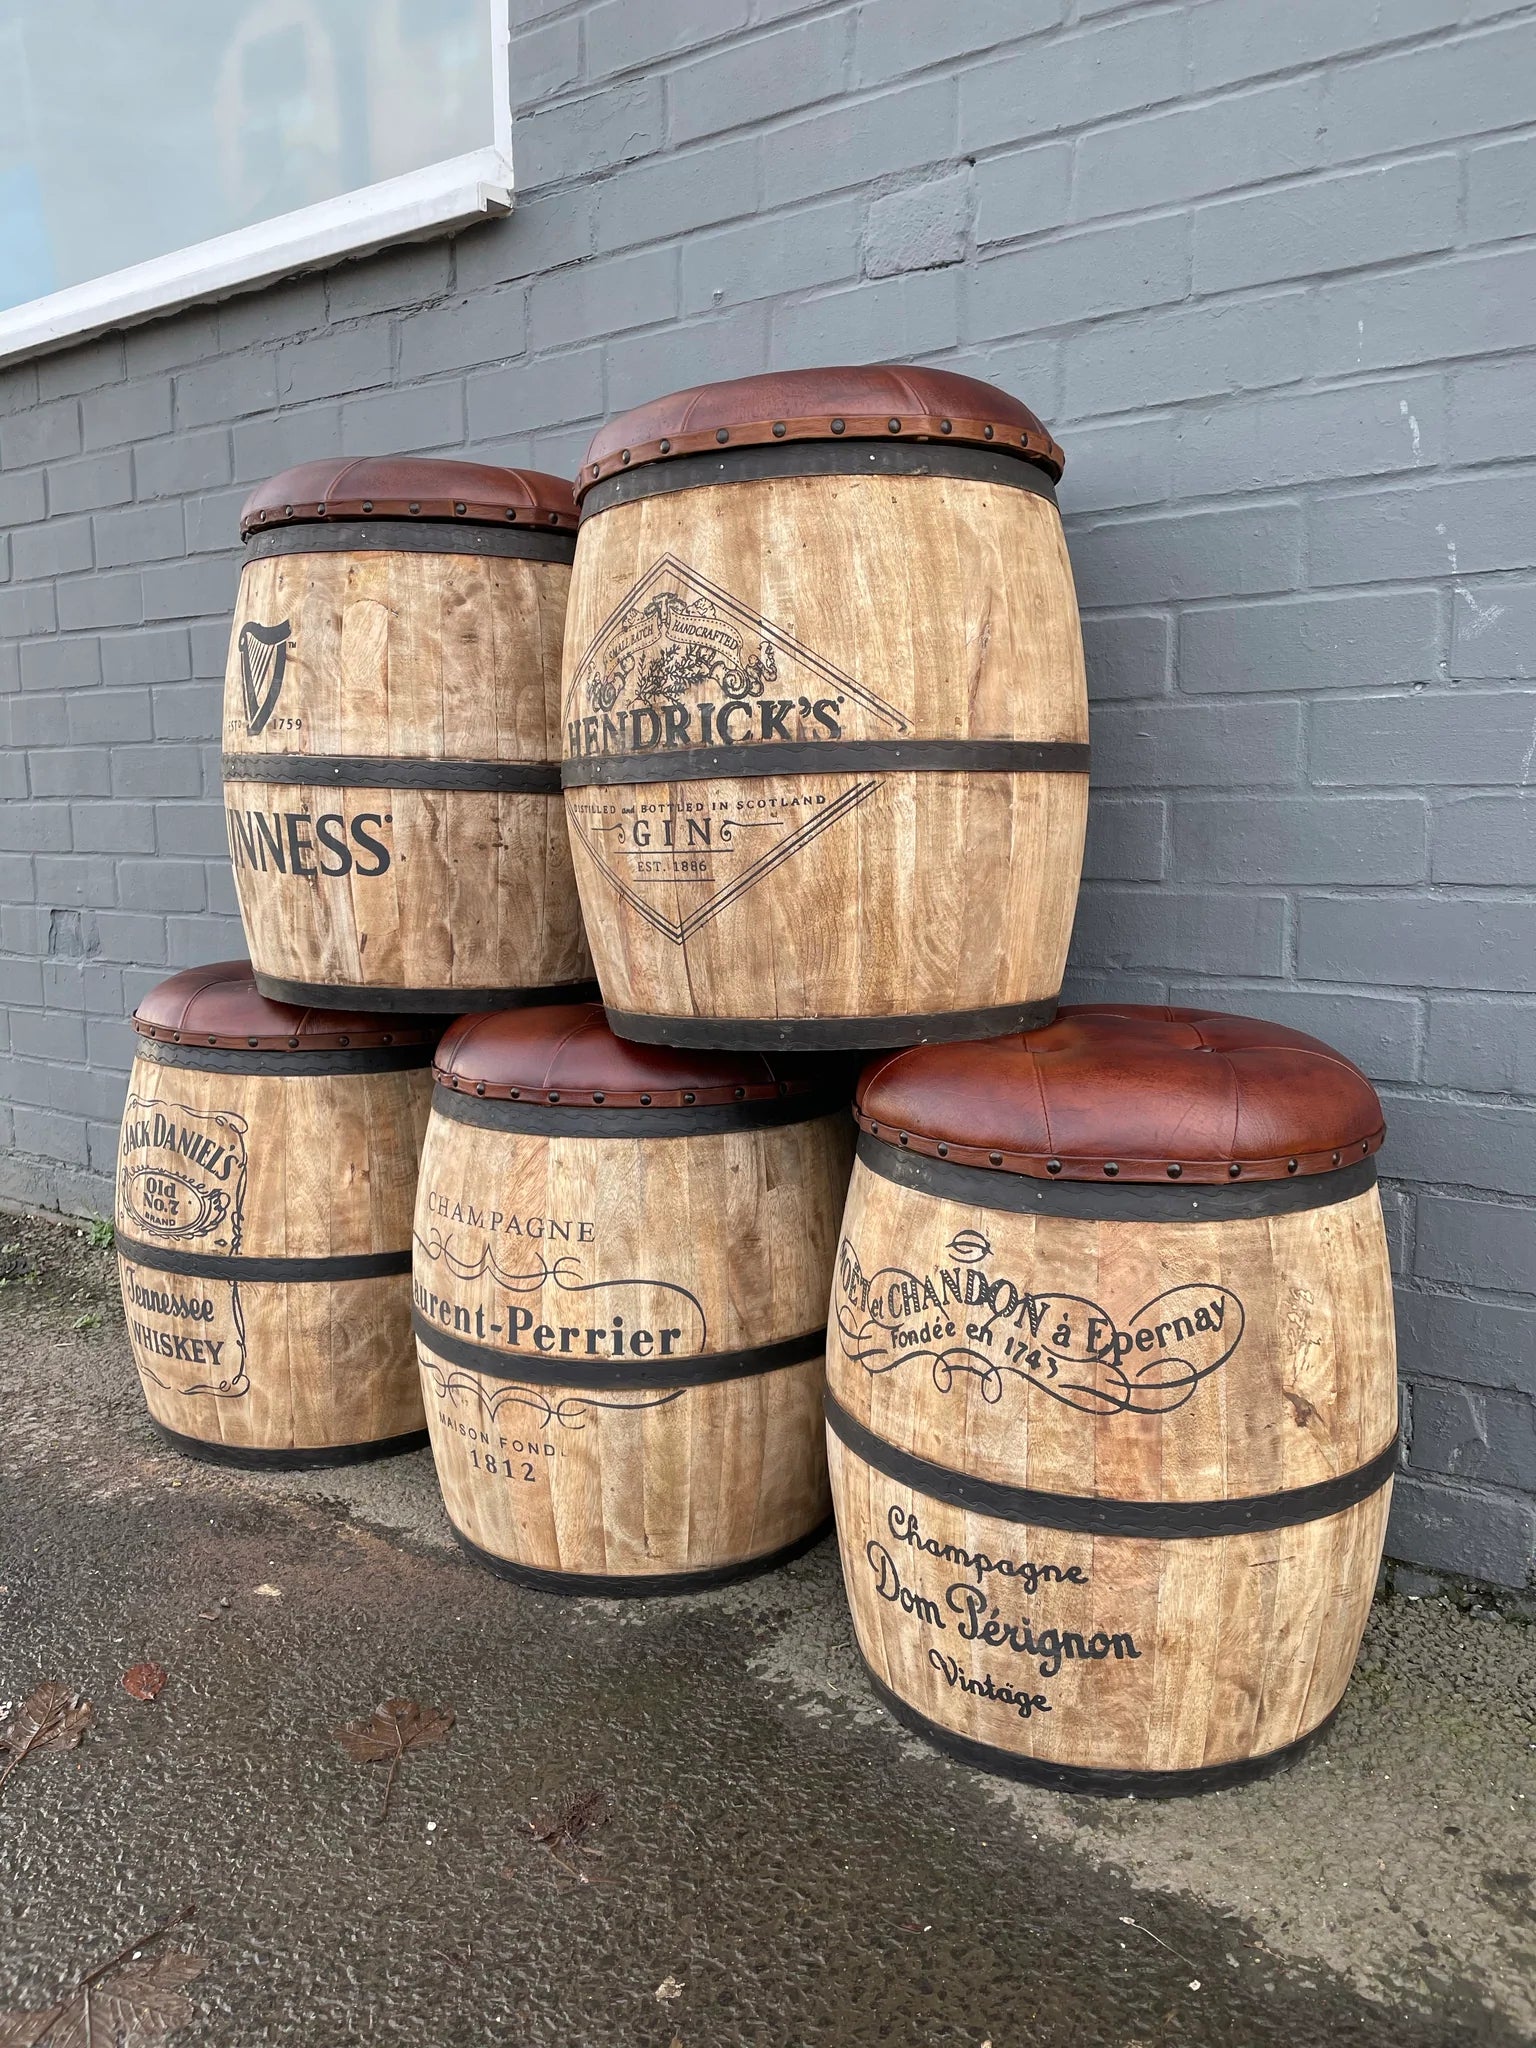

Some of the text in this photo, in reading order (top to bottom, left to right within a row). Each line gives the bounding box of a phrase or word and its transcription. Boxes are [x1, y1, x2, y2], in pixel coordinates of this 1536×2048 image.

[631, 623, 654, 646] BATCH
[671, 619, 738, 651] HANDCRAFTED
[273, 718, 303, 731] 1759
[574, 795, 827, 815] DISTILLED and BOTTLED IN SCOTLAND
[227, 808, 391, 878] NNESS
[633, 817, 713, 847] GIN
[637, 859, 707, 873] EST. 1886
[123, 1113, 239, 1181] JACK DANIEL'S
[146, 1177, 176, 1199] Old
[144, 1211, 176, 1227] BRAND
[428, 1191, 596, 1243] CHAMPAGNE
[126, 1266, 215, 1322] Tennessee
[871, 1295, 884, 1320] et
[888, 1267, 1051, 1338] CHANDON
[1052, 1312, 1072, 1348] à
[132, 1318, 225, 1366] WHISKEY
[966, 1322, 993, 1346] en
[1004, 1336, 1059, 1379] 1743
[439, 1411, 567, 1458] MAISON FOND
[470, 1449, 536, 1483] 1812
[887, 1504, 1090, 1595] Champagne
[866, 1540, 1143, 1678] Dom Pérignon
